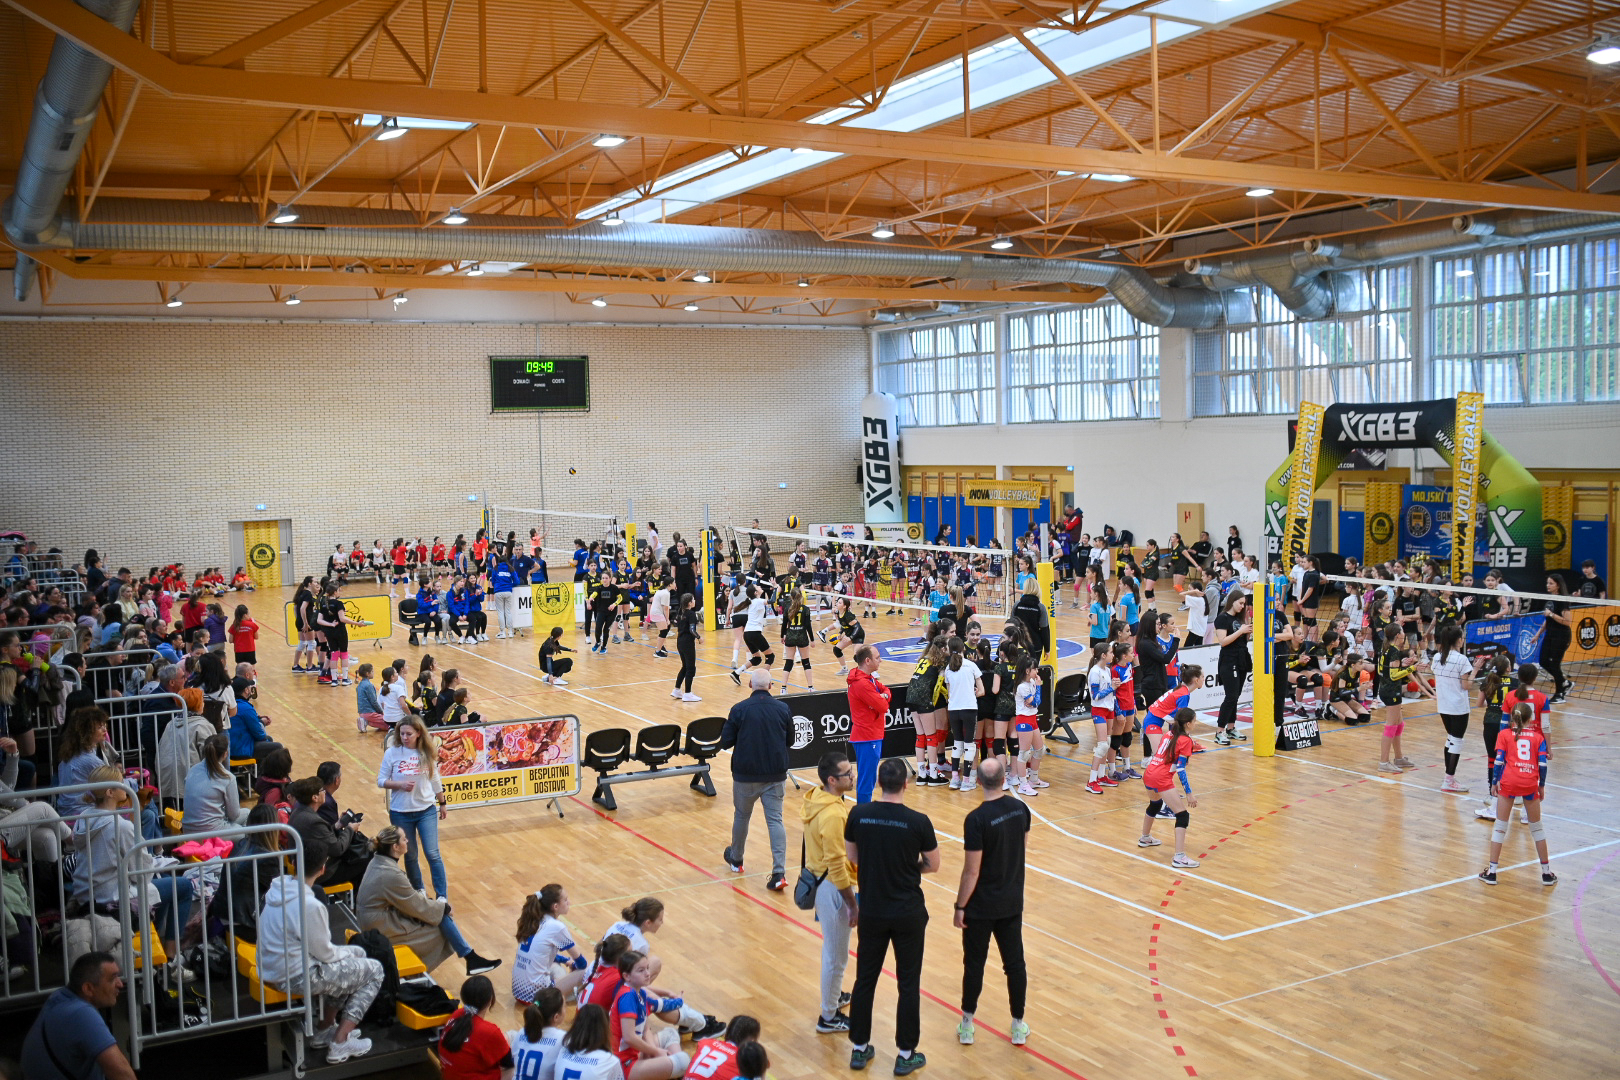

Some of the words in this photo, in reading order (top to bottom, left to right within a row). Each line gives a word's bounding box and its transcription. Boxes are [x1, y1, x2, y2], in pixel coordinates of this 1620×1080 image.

[526, 361, 554, 373] 09:49
[1411, 490, 1445, 503] MAJSKI
[1516, 739, 1531, 760] 8
[529, 765, 570, 781] BESPLATNA
[441, 780, 473, 793] STARI
[475, 776, 518, 788] RECEPT
[534, 779, 566, 794] DOSTAVA
[461, 791, 479, 801] 065
[481, 788, 499, 799] 998
[501, 786, 519, 796] 889
[689, 1045, 728, 1079] 13
